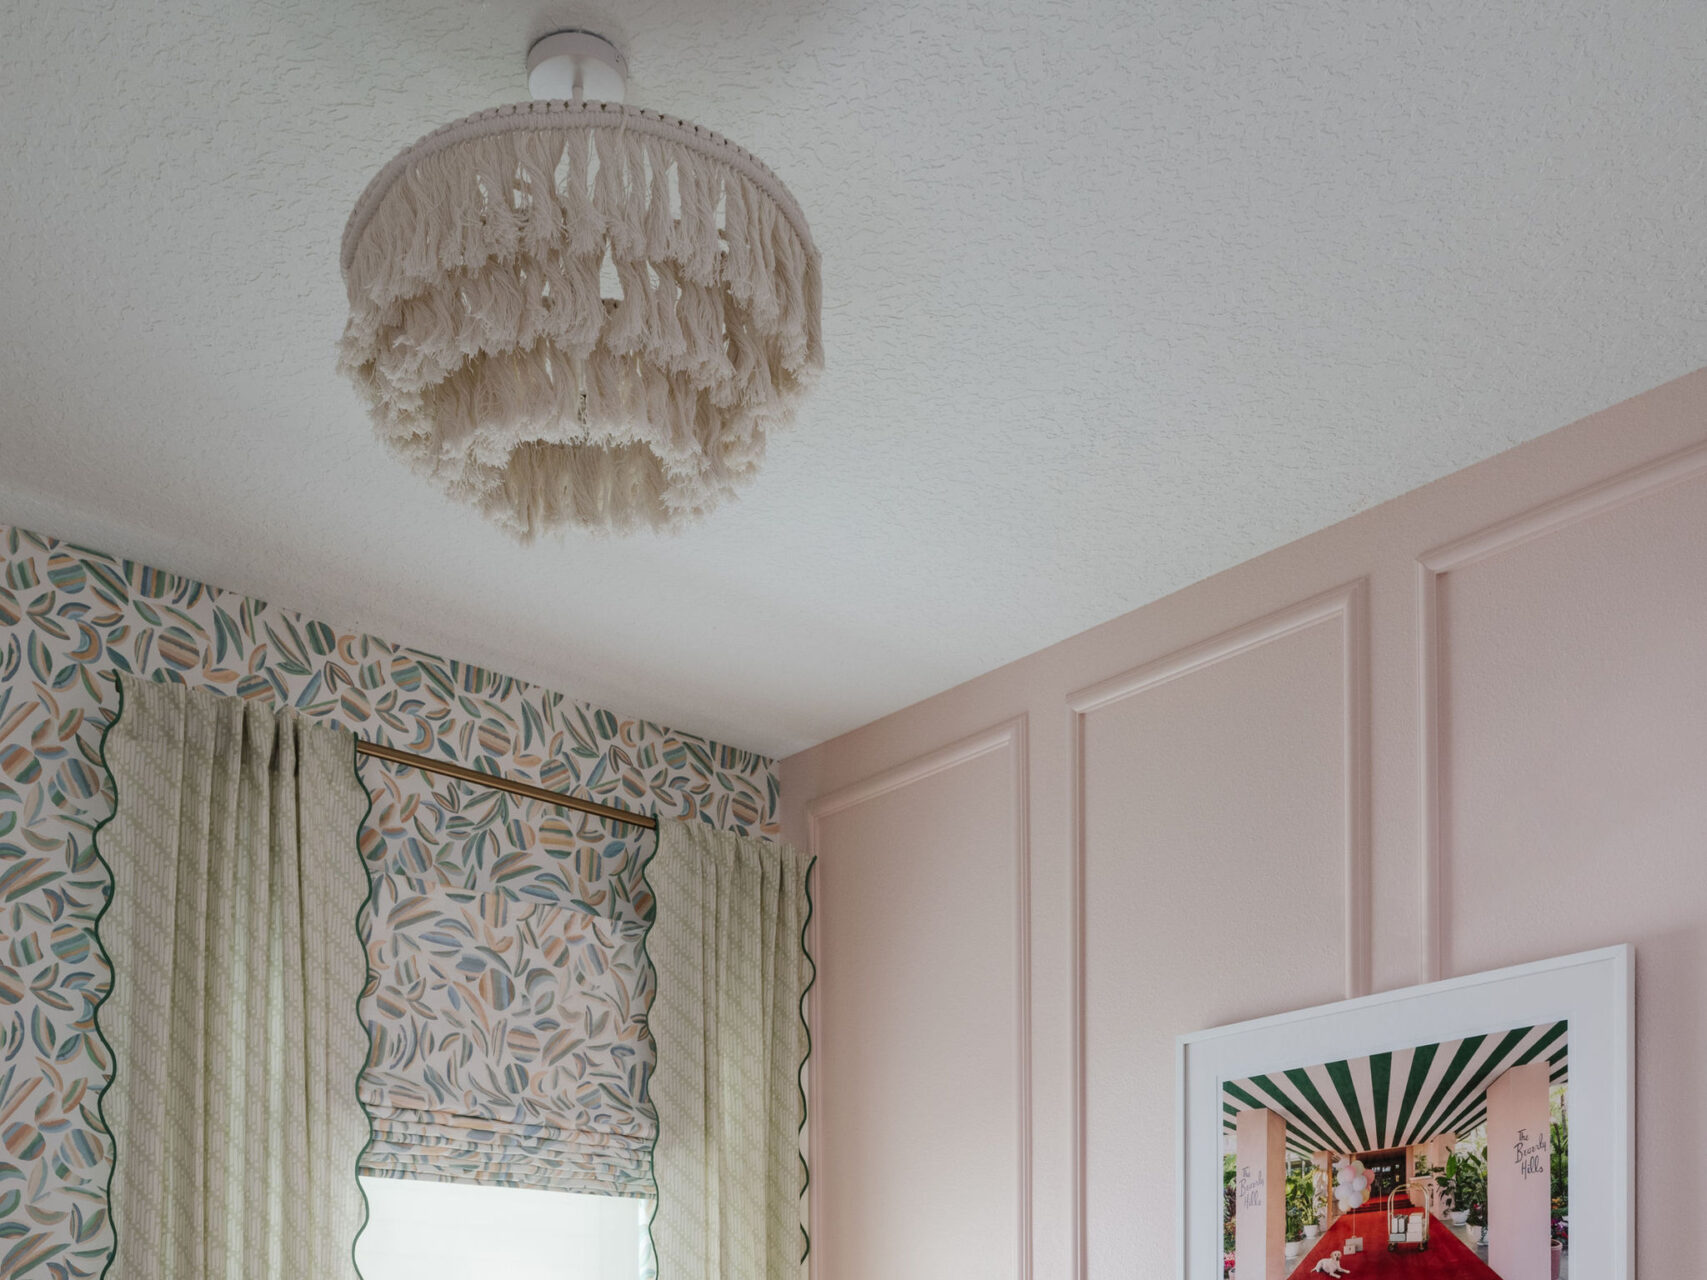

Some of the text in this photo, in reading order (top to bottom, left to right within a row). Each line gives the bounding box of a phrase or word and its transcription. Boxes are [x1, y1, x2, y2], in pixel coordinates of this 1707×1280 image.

[1517, 1128, 1529, 1141] The
[1514, 1133, 1547, 1164] Beverly
[1521, 1155, 1544, 1180] Hills
